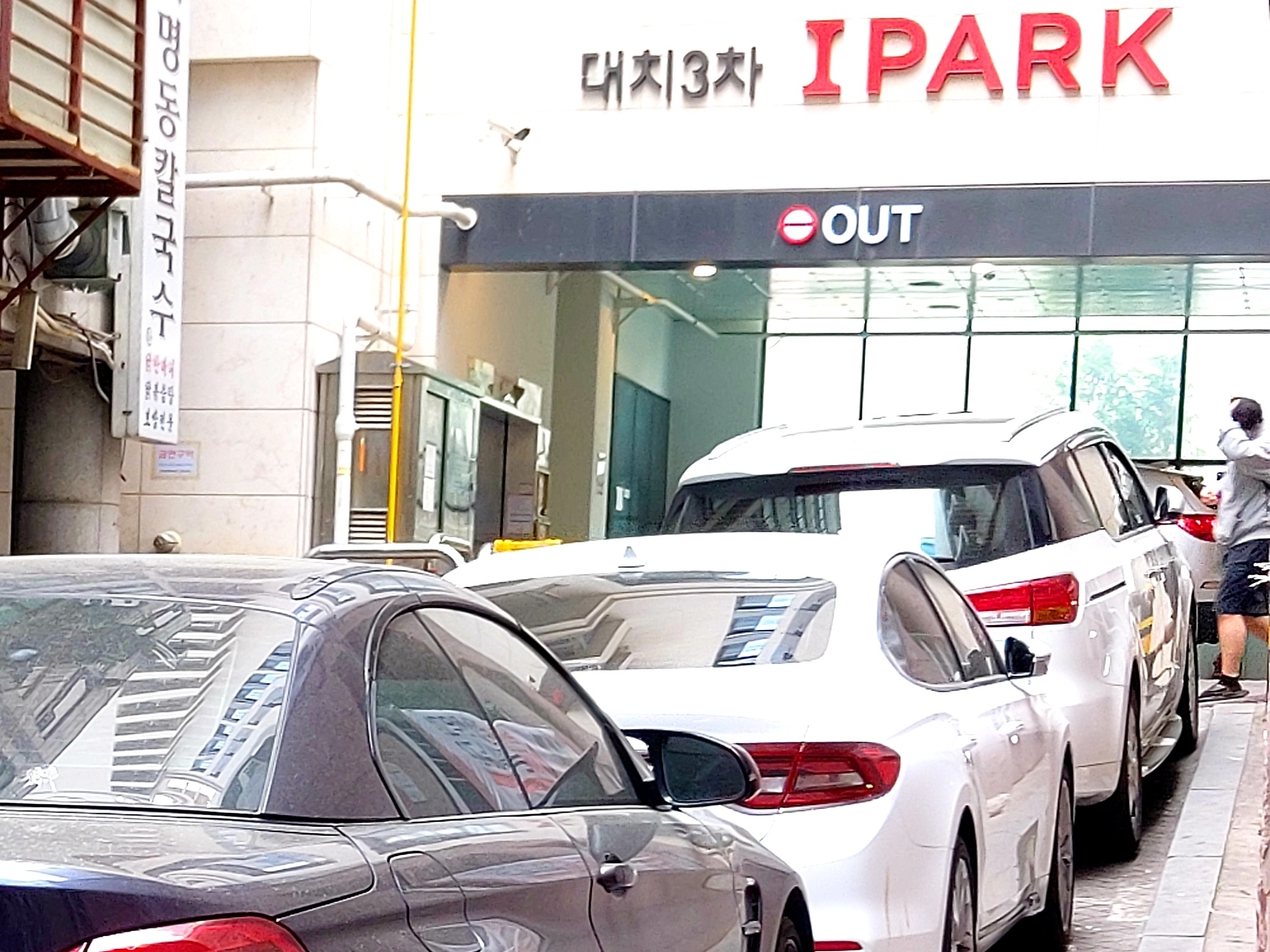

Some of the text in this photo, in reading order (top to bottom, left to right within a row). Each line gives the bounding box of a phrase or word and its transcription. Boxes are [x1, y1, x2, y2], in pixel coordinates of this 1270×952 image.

[581, 46, 763, 107] 대치3차
[150, 10, 181, 337] 명동칼국수
[821, 204, 924, 245] OUT
